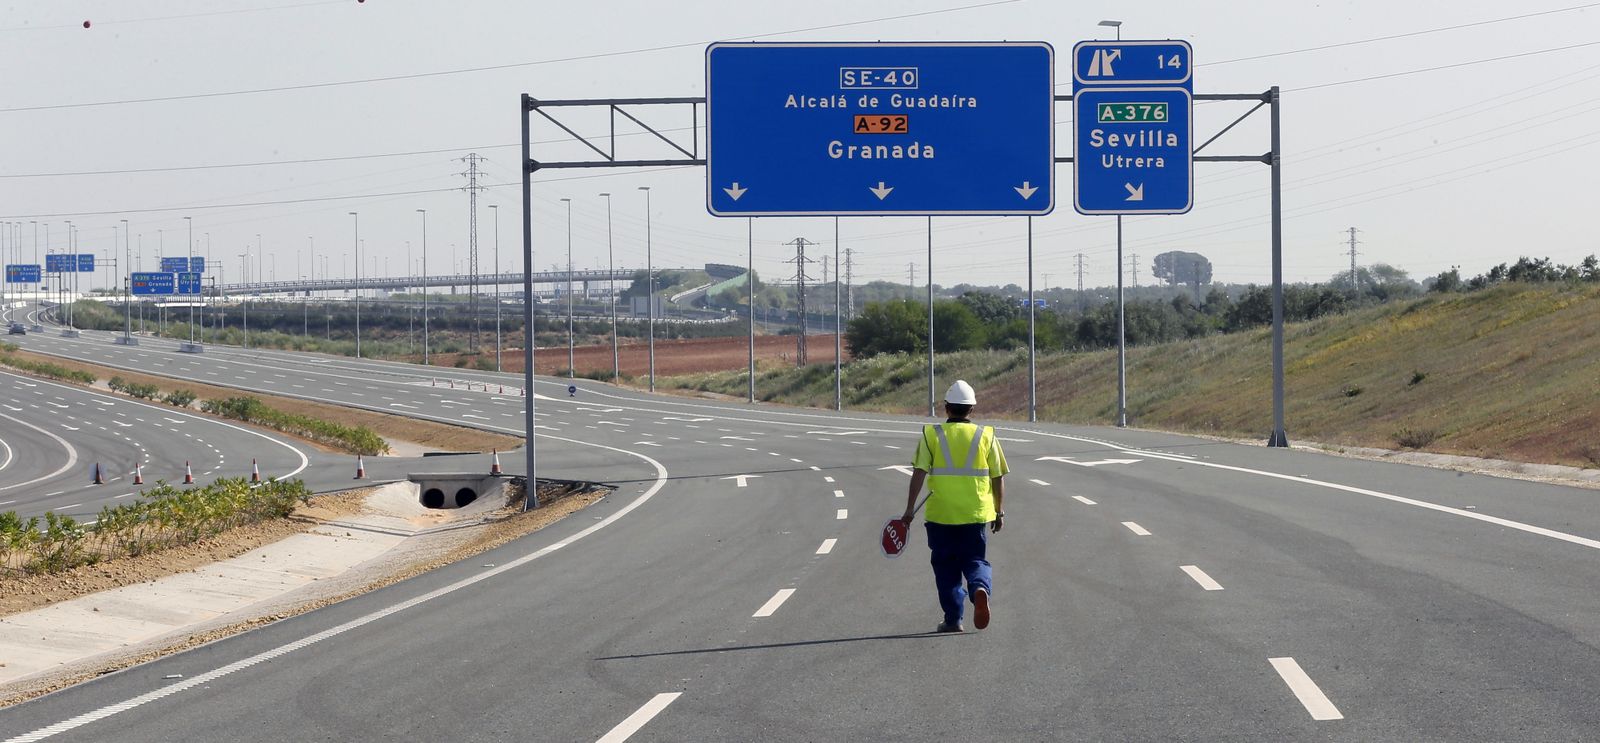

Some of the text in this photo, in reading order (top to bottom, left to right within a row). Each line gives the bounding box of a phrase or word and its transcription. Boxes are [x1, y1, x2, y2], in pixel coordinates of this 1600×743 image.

[1158, 54, 1182, 69] 14
[843, 70, 915, 86] SE-40
[784, 93, 977, 108] Alcalá de Guadaíra
[1101, 105, 1165, 121] A-376
[855, 117, 906, 132] A-92
[1089, 128, 1178, 148] Sevilla
[828, 140, 934, 159] Granada
[1102, 154, 1165, 168] Utrera
[886, 525, 903, 550] STOP
